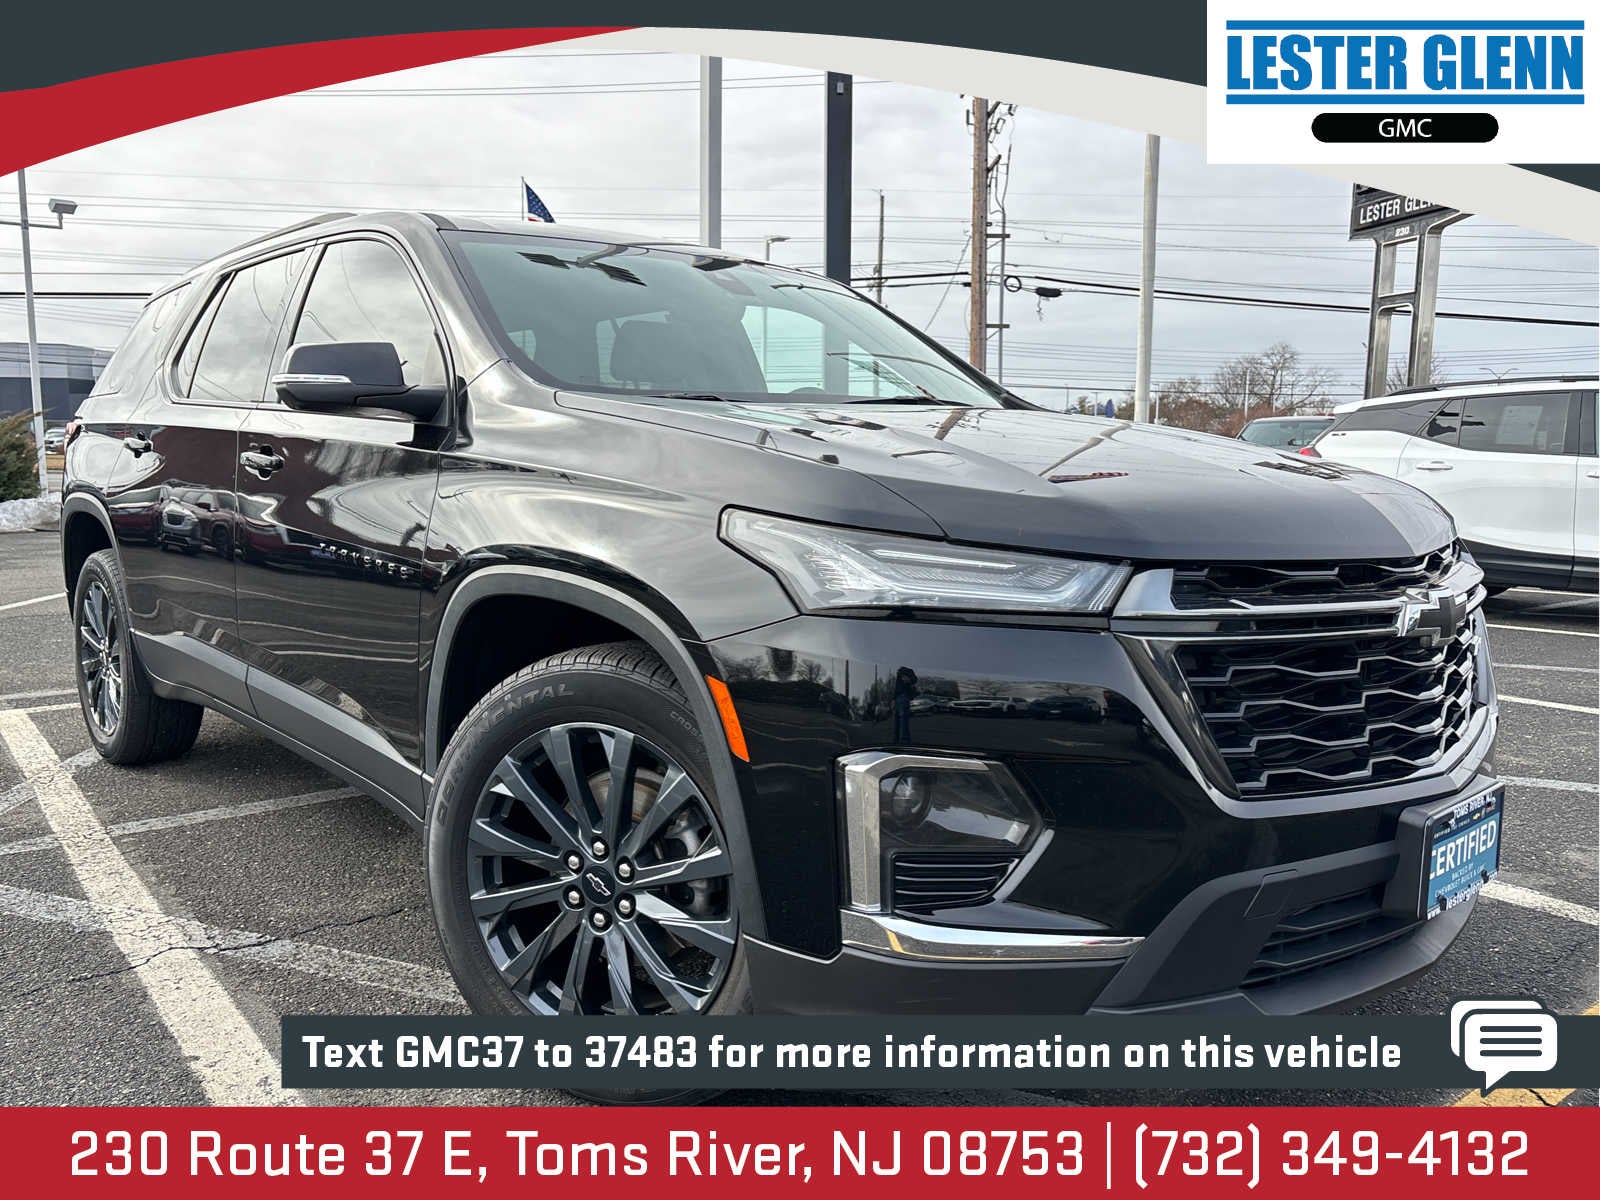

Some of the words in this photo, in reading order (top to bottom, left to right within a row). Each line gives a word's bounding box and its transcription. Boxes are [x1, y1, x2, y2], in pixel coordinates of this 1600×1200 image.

[1360, 199, 1400, 224] LESTER
[1405, 197, 1437, 212] GLE
[319, 542, 411, 579] TRAVERSE
